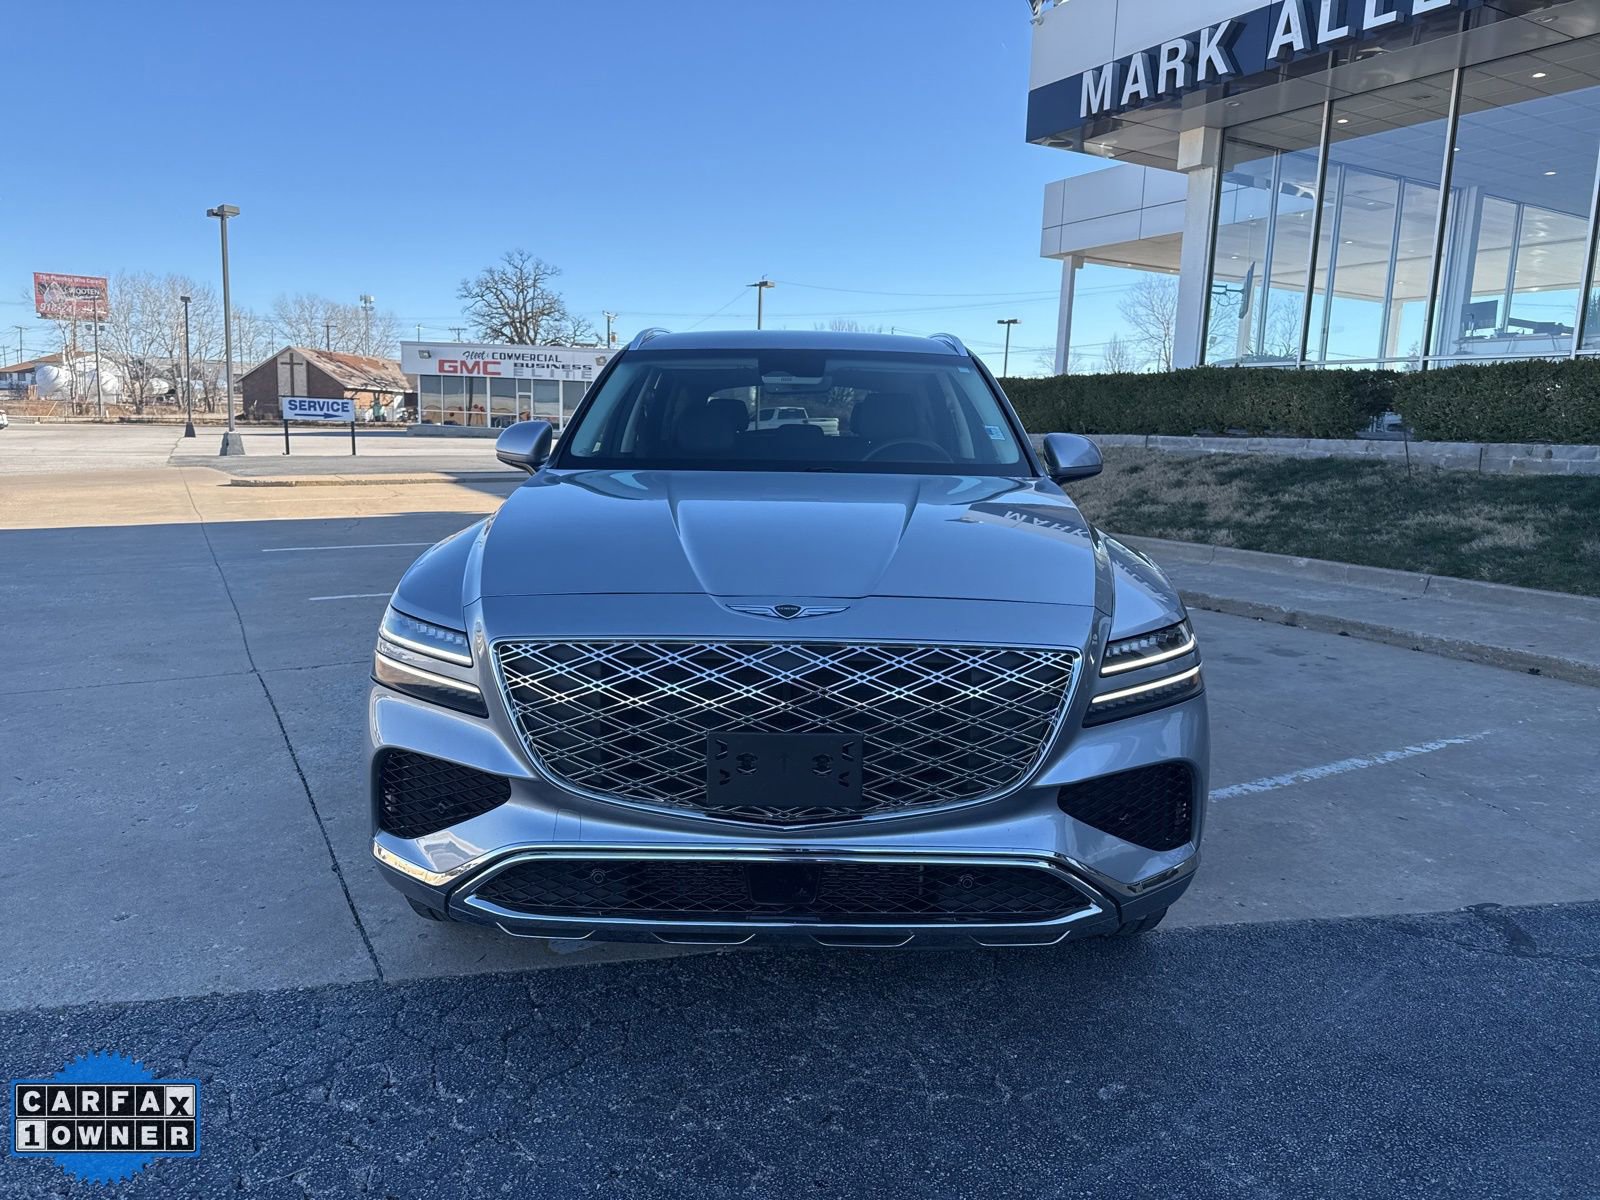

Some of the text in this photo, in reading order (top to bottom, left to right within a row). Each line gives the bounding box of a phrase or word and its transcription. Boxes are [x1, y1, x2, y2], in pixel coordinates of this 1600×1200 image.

[1079, 0, 1451, 118] MARK ALL
[462, 350, 486, 361] Fleet
[438, 359, 502, 376] GMC
[513, 362, 592, 370] BUSINESS
[513, 367, 592, 379] ELITE
[288, 399, 350, 413] SERVICE
